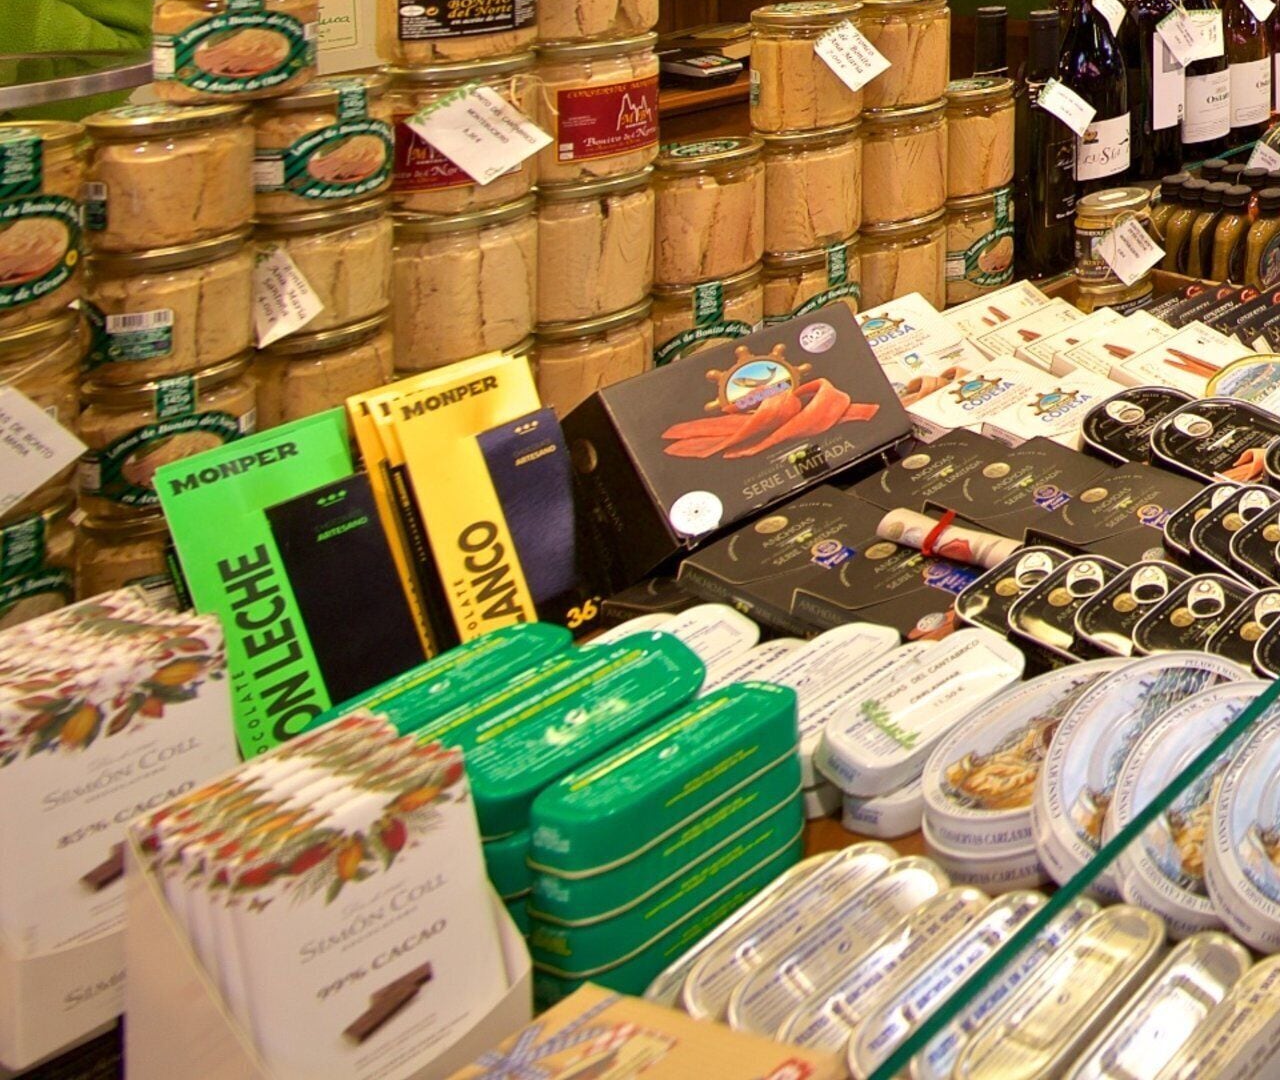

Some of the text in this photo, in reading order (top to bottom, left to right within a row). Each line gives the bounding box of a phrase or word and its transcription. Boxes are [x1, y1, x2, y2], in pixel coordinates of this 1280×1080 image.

[212, 15, 281, 27] de Bonito del
[447, 3, 513, 18] del Norte
[464, 13, 512, 24] aceite oliva
[831, 38, 844, 51] Ana
[838, 33, 872, 67] de Bonito
[853, 32, 874, 56] Tronco
[193, 73, 288, 91] en Aceite de Oliva
[292, 122, 370, 155] Lomos de Bonito
[583, 132, 634, 148] Bonito del
[305, 183, 367, 197] en Aceite de
[4, 199, 57, 216] de Bonito
[271, 266, 286, 286] Ana
[14, 288, 31, 302] de
[816, 287, 849, 305] de Bonito
[658, 323, 738, 357] Lomos de Bonito del
[402, 375, 499, 421] MONPER
[961, 378, 1016, 412] CODESA
[1041, 392, 1093, 424] CODESA
[107, 417, 215, 460] Lomos de Bonito del
[169, 440, 299, 497] MONPER
[514, 443, 558, 467] ARTESANO
[741, 438, 855, 501] SERIE LIMITADA
[909, 454, 956, 482] ANCHOAS
[922, 458, 985, 497] SERIE LIMITADA
[990, 464, 1036, 491] ANCHOAS
[1003, 488, 1028, 506] SERIE
[1091, 486, 1132, 515] ANCHOAS
[316, 516, 369, 543] ARTESANO
[762, 516, 816, 550] ANCHOAS
[772, 520, 849, 568] SERIE LIMITADA
[218, 542, 303, 659] LECHE
[566, 602, 598, 630] 36
[911, 640, 980, 684] DEL CANTABRICO
[139, 737, 202, 769] COLL
[113, 780, 196, 824] CACAO
[1045, 756, 1062, 819] CONSERVAS
[1217, 777, 1237, 854] CONSERVAS
[389, 873, 447, 911] COLL
[316, 919, 448, 1000] 99% CACAO
